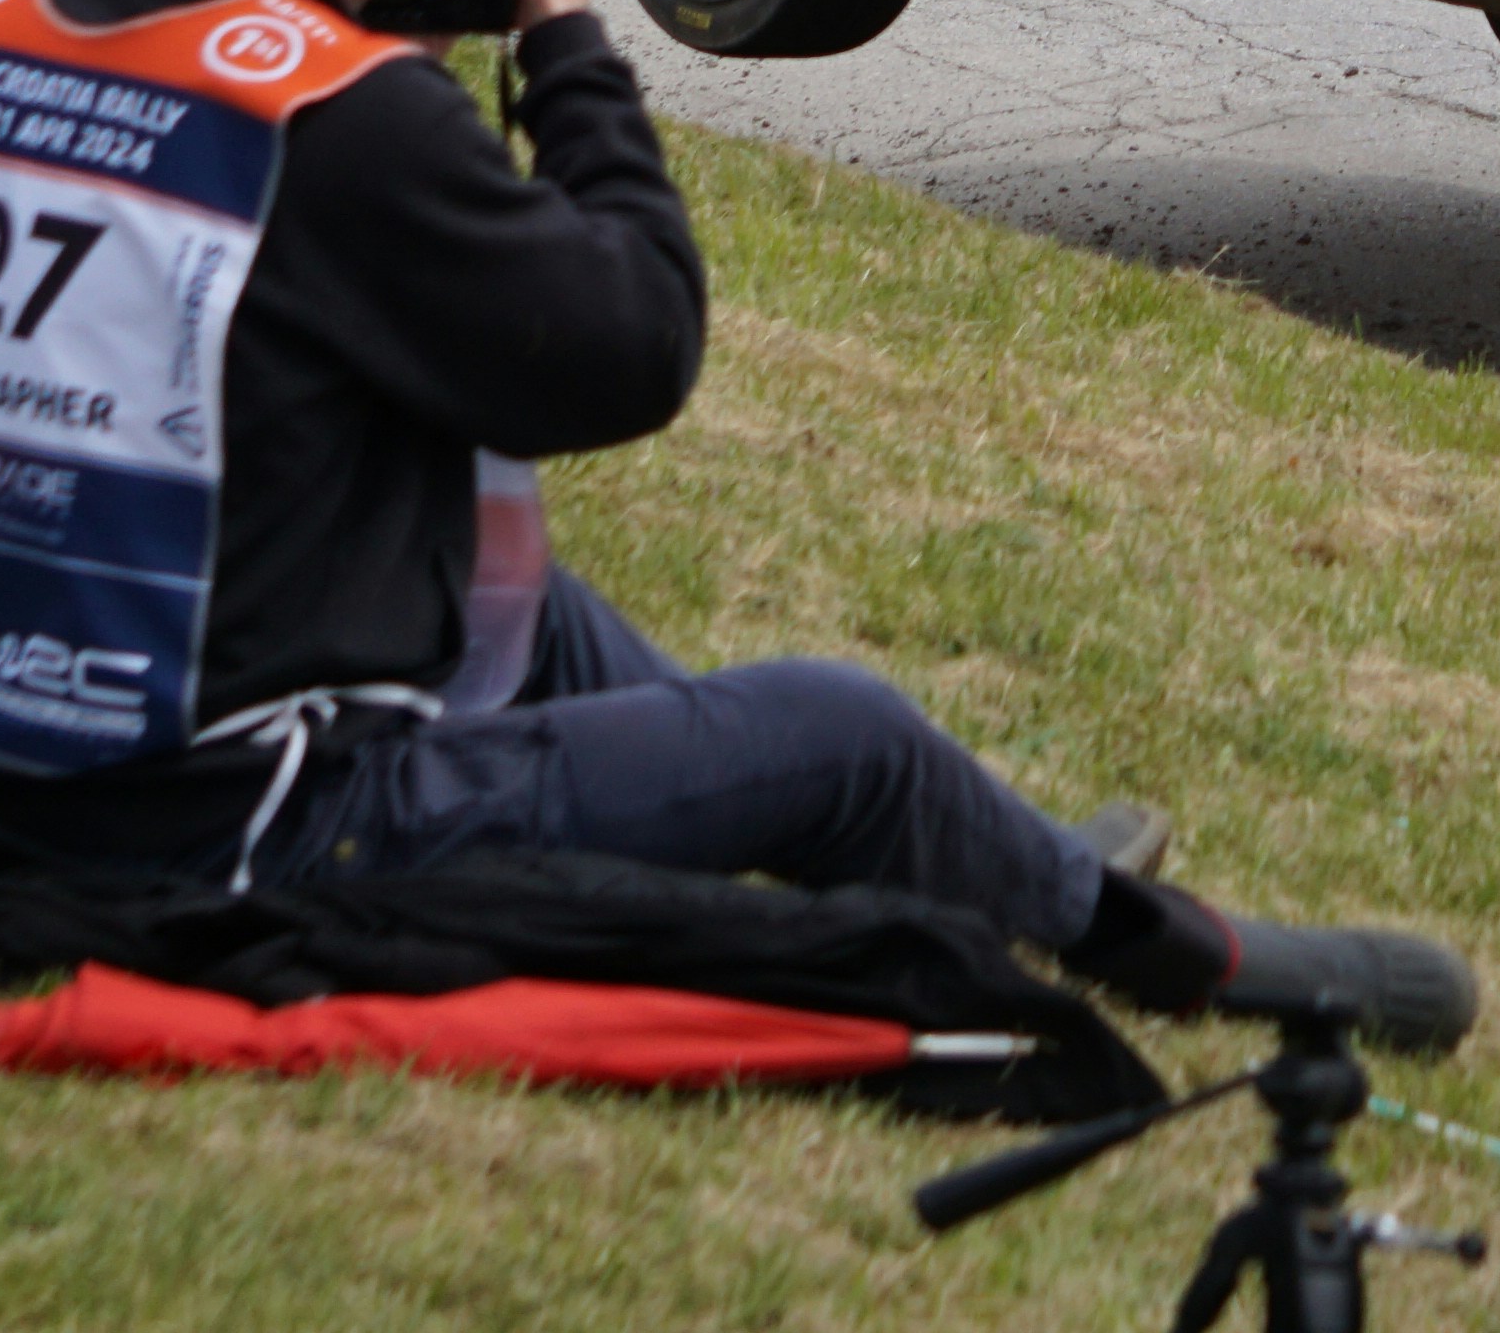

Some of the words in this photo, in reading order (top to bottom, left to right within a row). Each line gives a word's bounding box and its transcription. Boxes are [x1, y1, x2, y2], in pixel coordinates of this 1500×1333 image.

[99, 85, 191, 135] RALLY
[13, 110, 77, 154] APR
[71, 126, 157, 174] 2024
